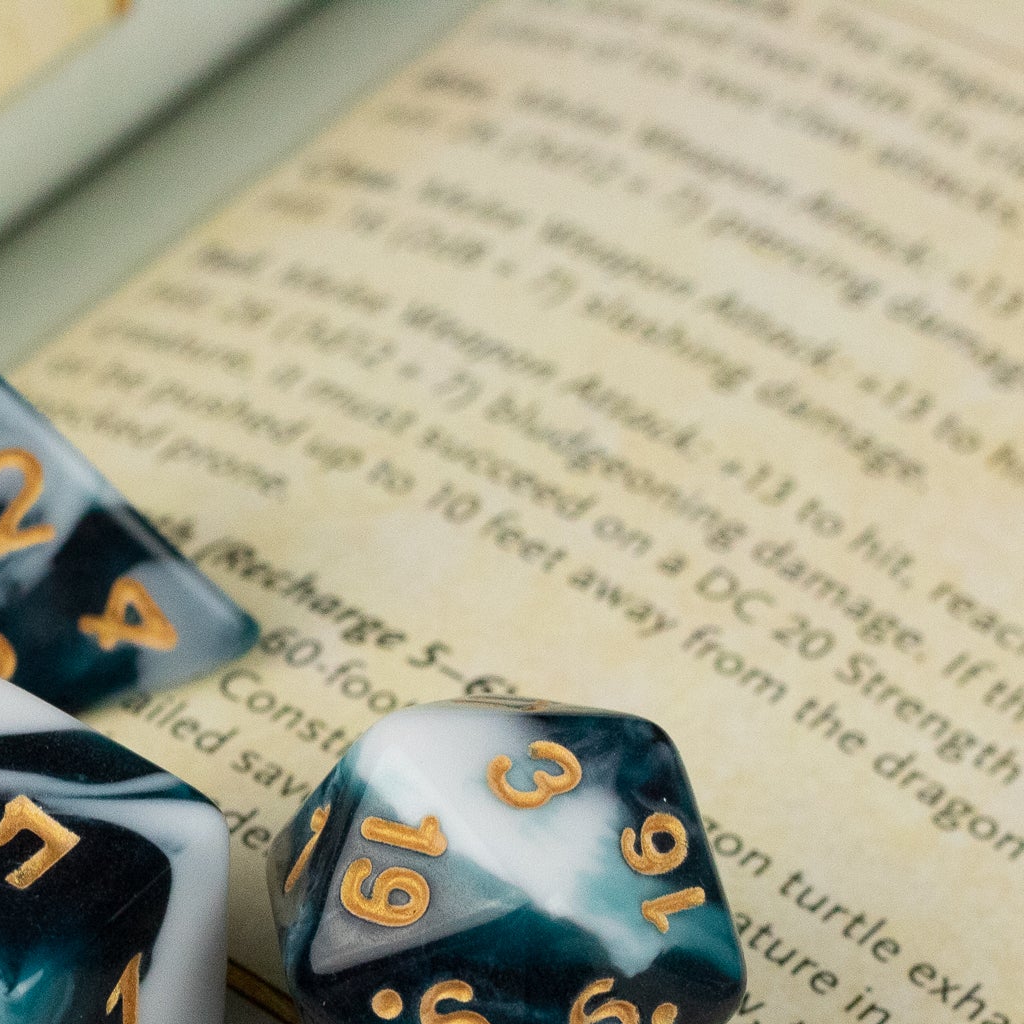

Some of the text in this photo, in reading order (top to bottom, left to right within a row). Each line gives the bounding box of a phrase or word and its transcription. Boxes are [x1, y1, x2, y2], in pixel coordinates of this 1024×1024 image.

[482, 392, 749, 553] bludgeoning
[750, 538, 927, 664] damage.
[981, 673, 1024, 725] th
[796, 497, 845, 540] to
[79, 576, 179, 652] 4
[416, 424, 598, 521] succeed
[592, 514, 654, 558] on
[656, 551, 690, 577] a
[694, 563, 775, 627] DC
[772, 610, 838, 662] 20
[834, 649, 1024, 787] Strength
[426, 480, 481, 525] 10
[482, 509, 570, 576] feet
[568, 563, 678, 642] away
[681, 621, 788, 706] from
[792, 696, 869, 758] the
[258, 625, 400, 713] 60-foo
[230, 749, 311, 800] sav
[488, 741, 582, 810] 3
[733, 910, 839, 996] ature
[779, 868, 902, 964] turtle
